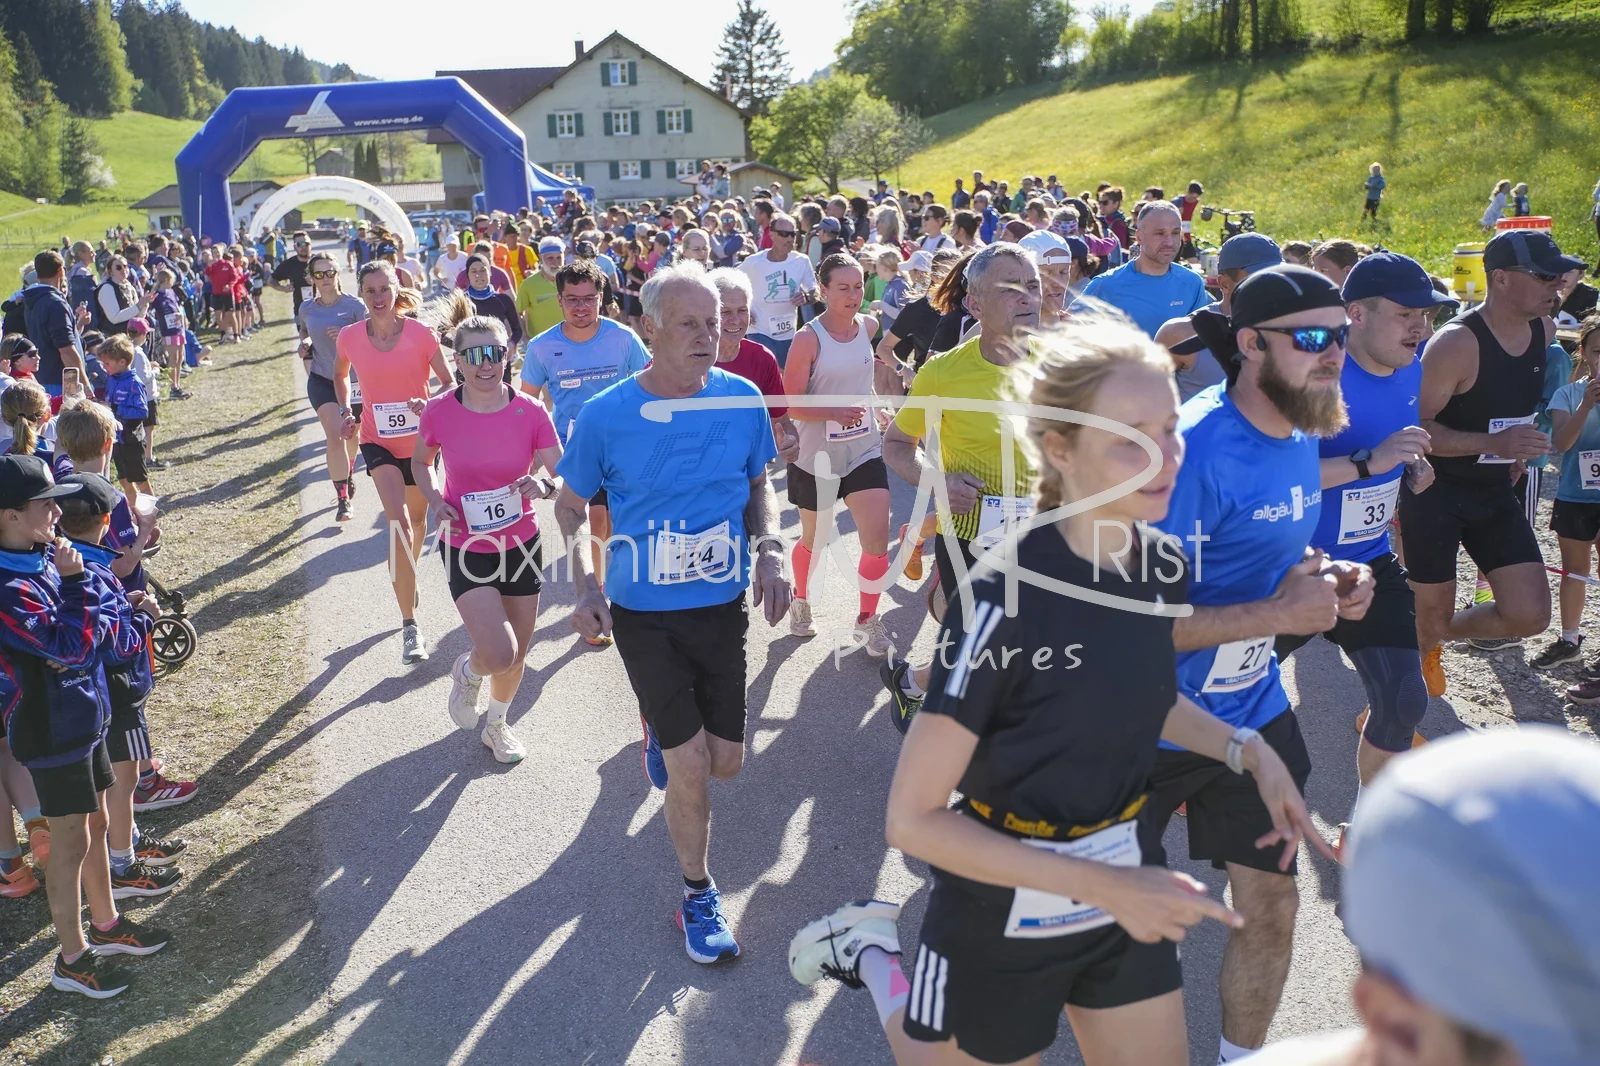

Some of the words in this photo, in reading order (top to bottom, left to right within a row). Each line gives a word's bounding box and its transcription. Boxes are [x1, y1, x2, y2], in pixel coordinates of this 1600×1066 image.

[354, 115, 424, 127] www.sv-mg.de
[776, 321, 792, 331] 105
[388, 414, 406, 428] 59
[484, 502, 506, 521] 16
[1252, 501, 1293, 522] allgäu
[1363, 502, 1386, 526] 33
[675, 545, 715, 569] 124
[1237, 640, 1268, 672] 27
